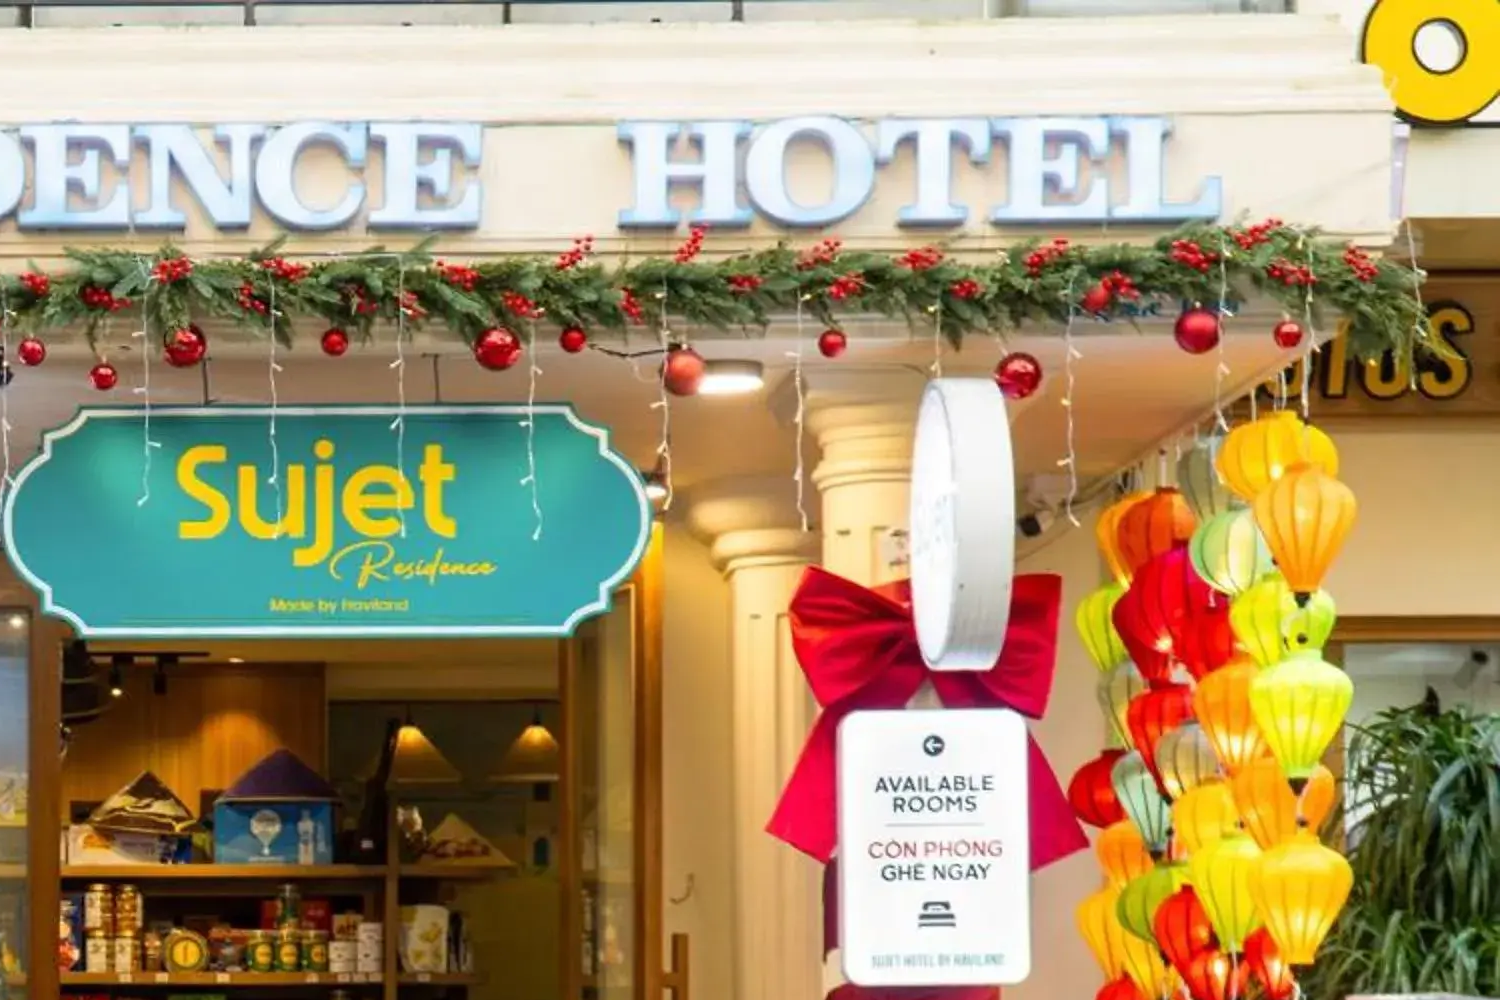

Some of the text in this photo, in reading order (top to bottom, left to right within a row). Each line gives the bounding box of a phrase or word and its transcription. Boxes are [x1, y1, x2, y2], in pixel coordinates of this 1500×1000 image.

[616, 113, 1223, 229] HOTEL
[177, 440, 458, 567] Sujet
[329, 540, 497, 590] Residence
[874, 774, 996, 793] AVAILABLE
[892, 795, 978, 814] ROOMS
[932, 863, 992, 881] NGAY
